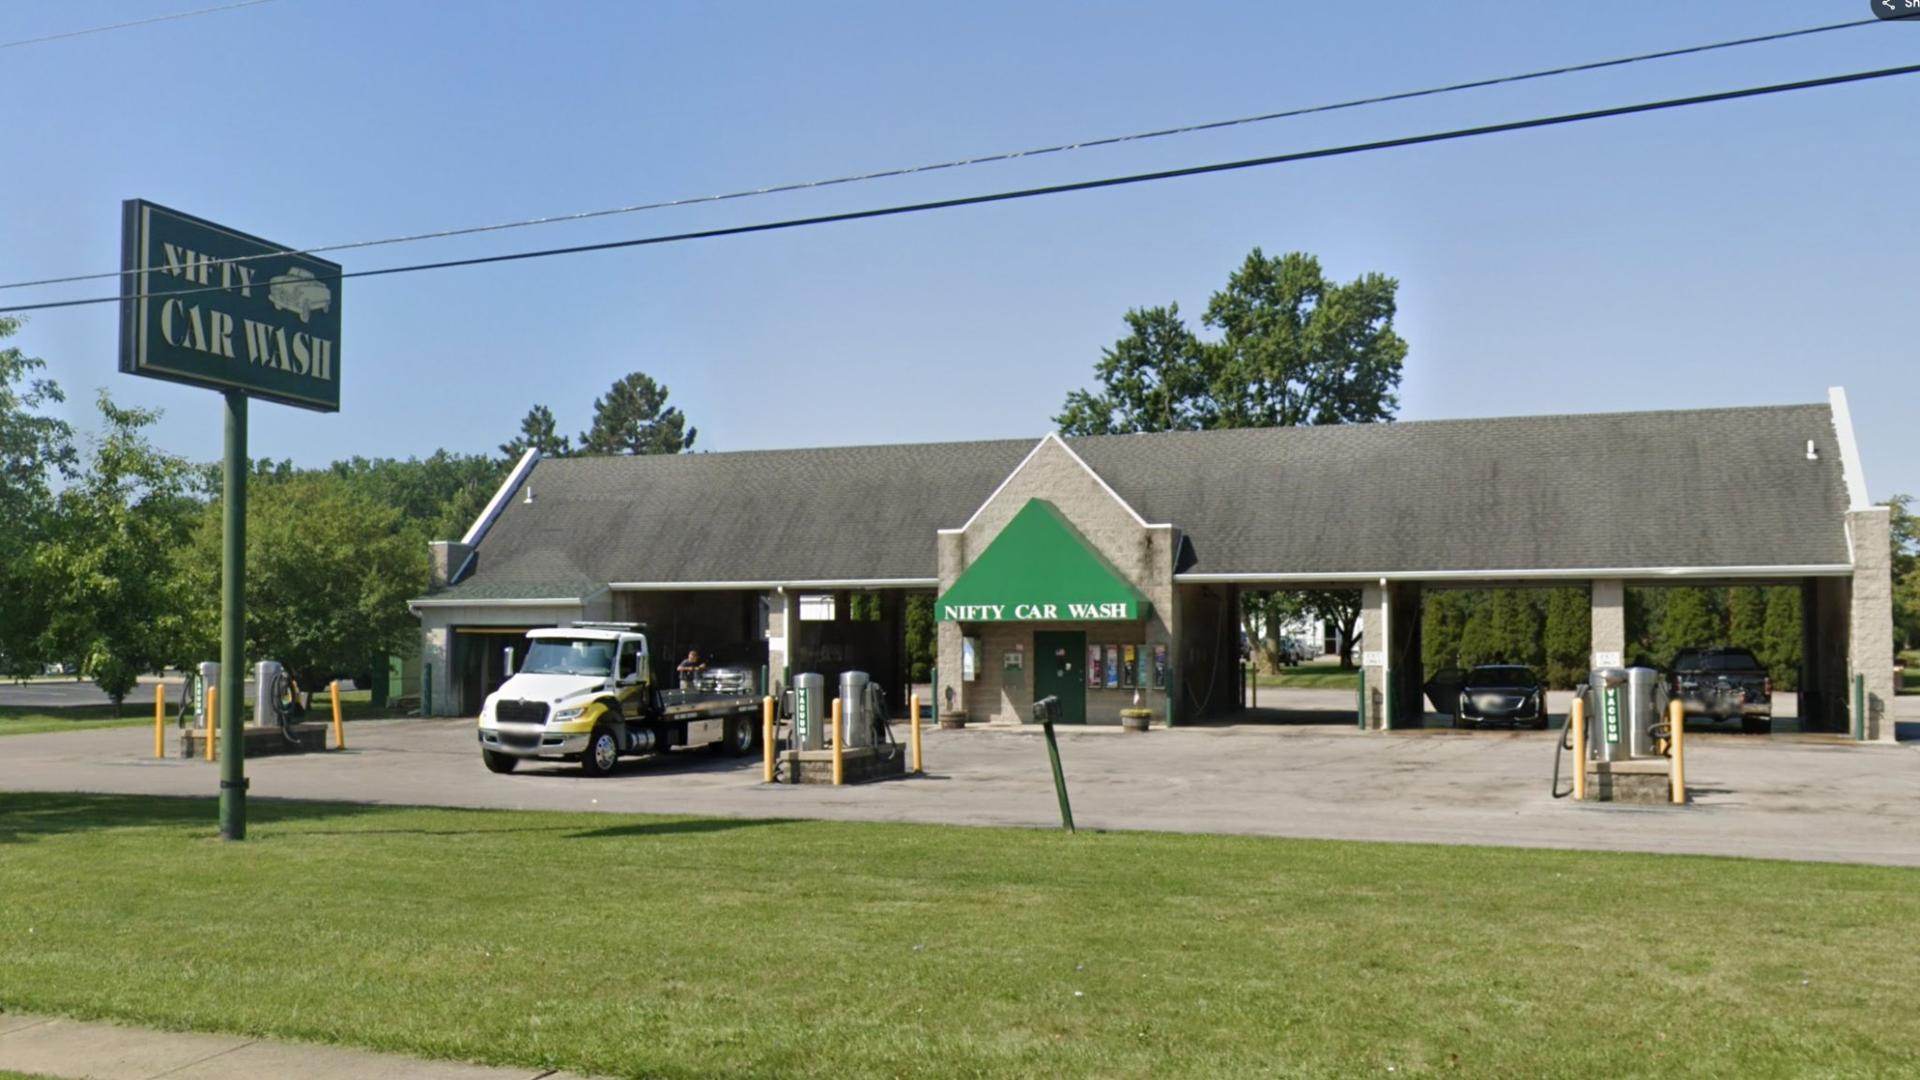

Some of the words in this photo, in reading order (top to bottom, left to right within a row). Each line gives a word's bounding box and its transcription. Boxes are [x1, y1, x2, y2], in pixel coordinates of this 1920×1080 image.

[161, 242, 256, 298] NIFTY
[161, 298, 235, 359] CAR
[243, 318, 332, 381] WASH
[944, 604, 1006, 620] NIFTY
[1014, 604, 1058, 620] CAR
[1068, 603, 1127, 619] WASH
[799, 689, 807, 735] VACUUM
[1607, 689, 1618, 742] VACUUM
